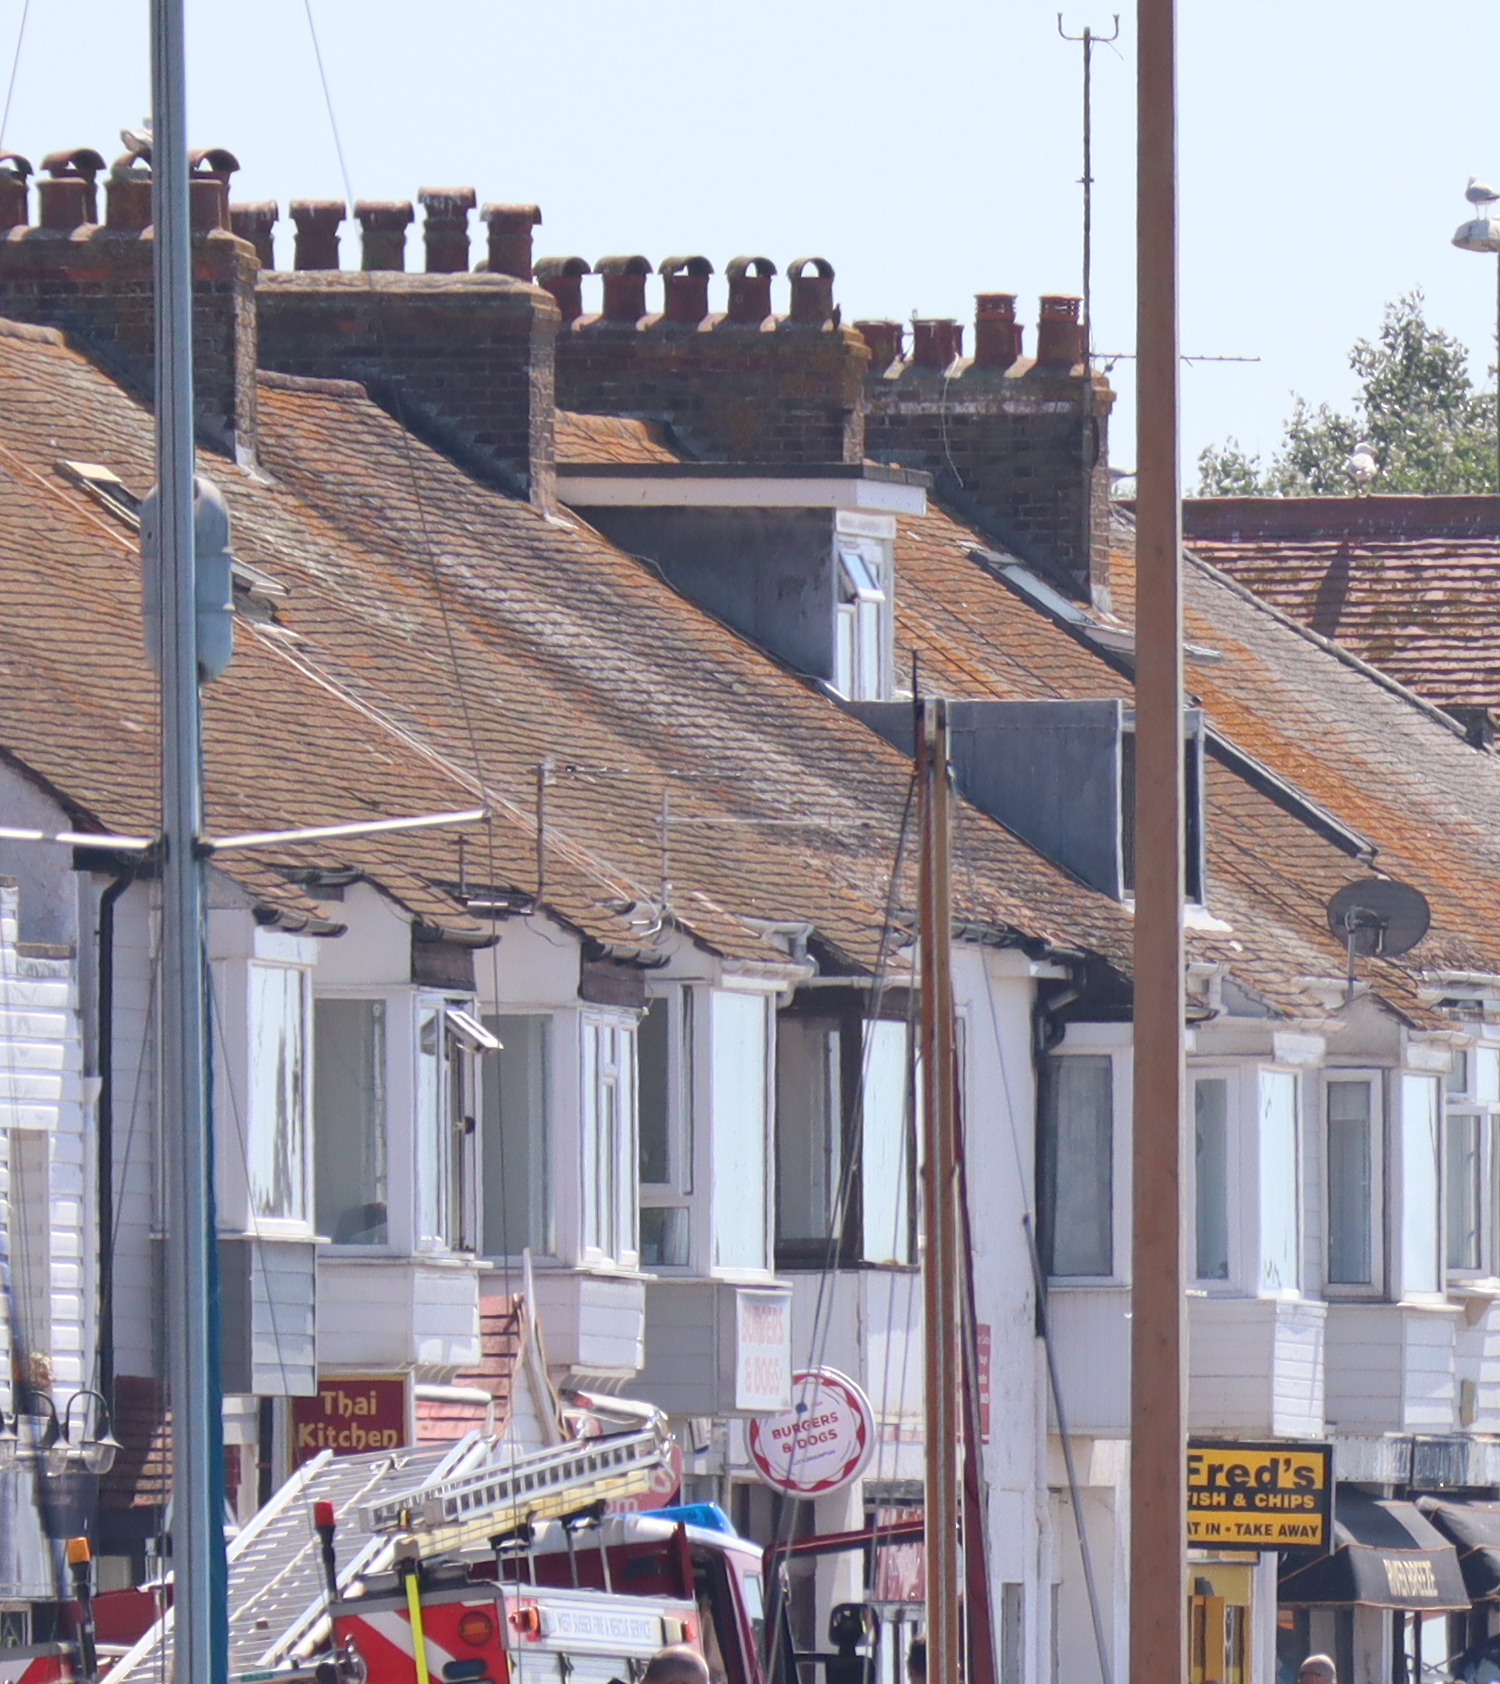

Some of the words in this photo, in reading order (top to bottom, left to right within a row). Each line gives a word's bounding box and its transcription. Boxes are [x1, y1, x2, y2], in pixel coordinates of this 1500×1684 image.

[320, 1390, 377, 1419] Thai
[298, 1422, 399, 1450] Kitchen
[771, 1411, 840, 1440] BURGERS
[782, 1442, 795, 1454] &
[796, 1428, 838, 1450] DOGS
[1187, 1454, 1316, 1489] Fred's
[1232, 1493, 1247, 1507] &
[1254, 1493, 1315, 1509] CHIPS
[1205, 1523, 1221, 1536] IN
[1234, 1523, 1273, 1537] TAKE
[1277, 1524, 1319, 1538] AWAY
